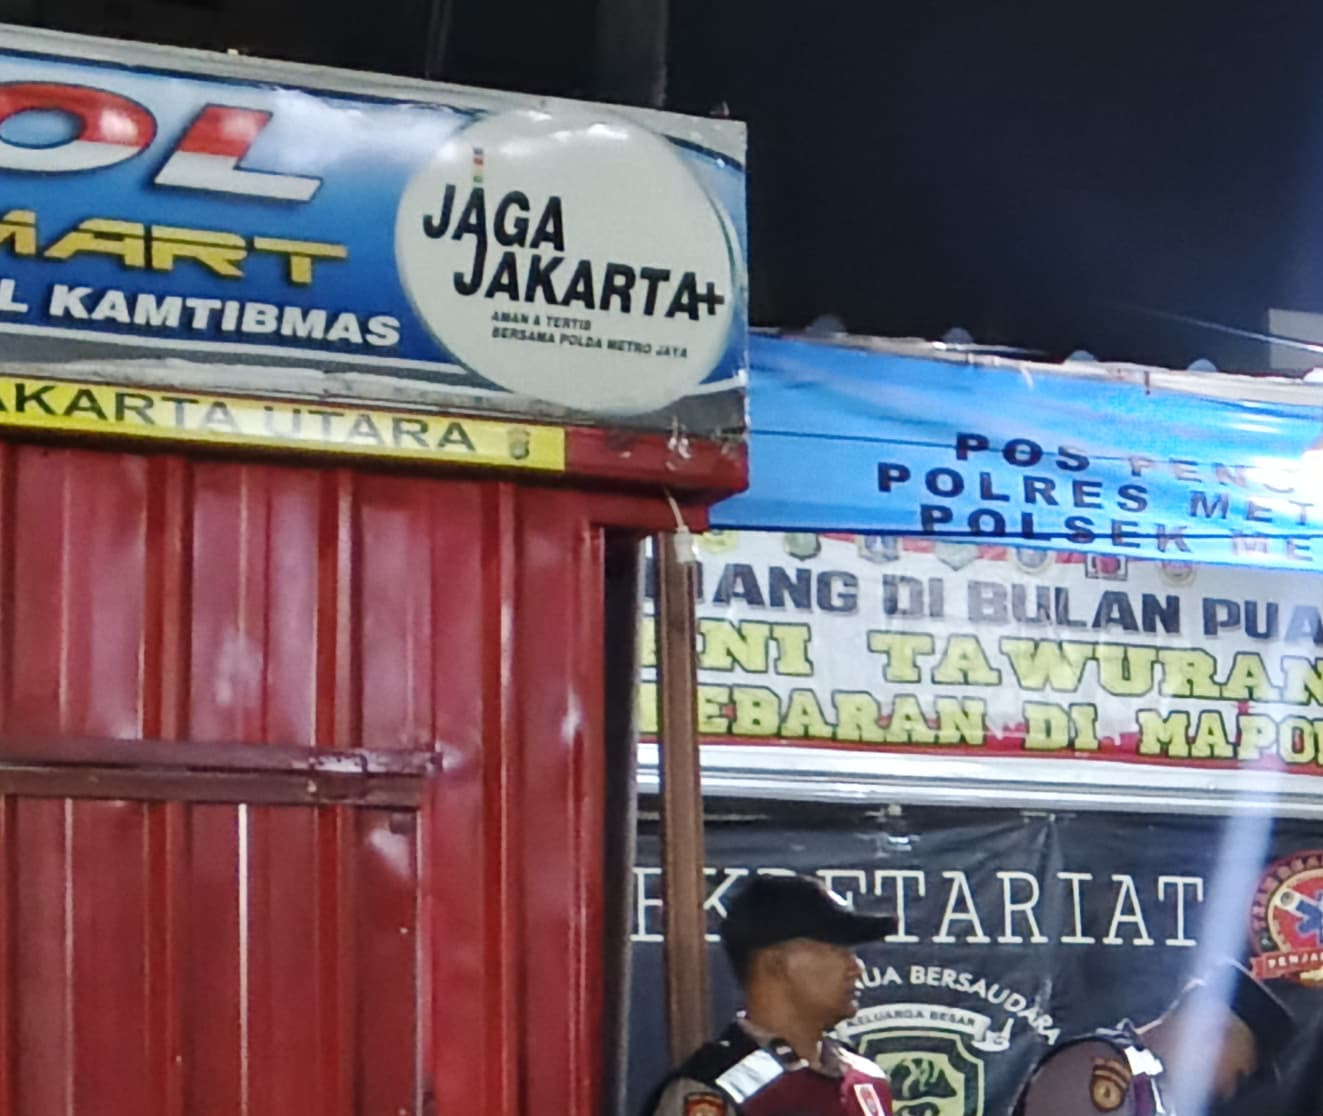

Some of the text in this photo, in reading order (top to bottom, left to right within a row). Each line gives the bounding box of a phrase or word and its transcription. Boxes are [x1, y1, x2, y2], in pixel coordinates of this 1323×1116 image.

[423, 184, 565, 251] JAGA
[453, 242, 725, 321] JAKARTA+
[49, 284, 401, 347] KAMTIBMAS
[491, 311, 529, 326] AMAN
[546, 315, 592, 331] TERTIB
[491, 326, 688, 359] BERSAMA POLDA METRO JAYA
[0, 383, 476, 452] KARTA UTARA
[955, 432, 1091, 473] POS
[877, 461, 1149, 513] POLRES
[919, 504, 1192, 553] POLSEK
[644, 557, 859, 614] ANG
[881, 573, 945, 618] DI
[967, 580, 1181, 636] BULAN
[1023, 702, 1100, 752] DI
[910, 964, 1062, 1047] BERSAUDARA
[929, 1008, 976, 1027] BESAR
